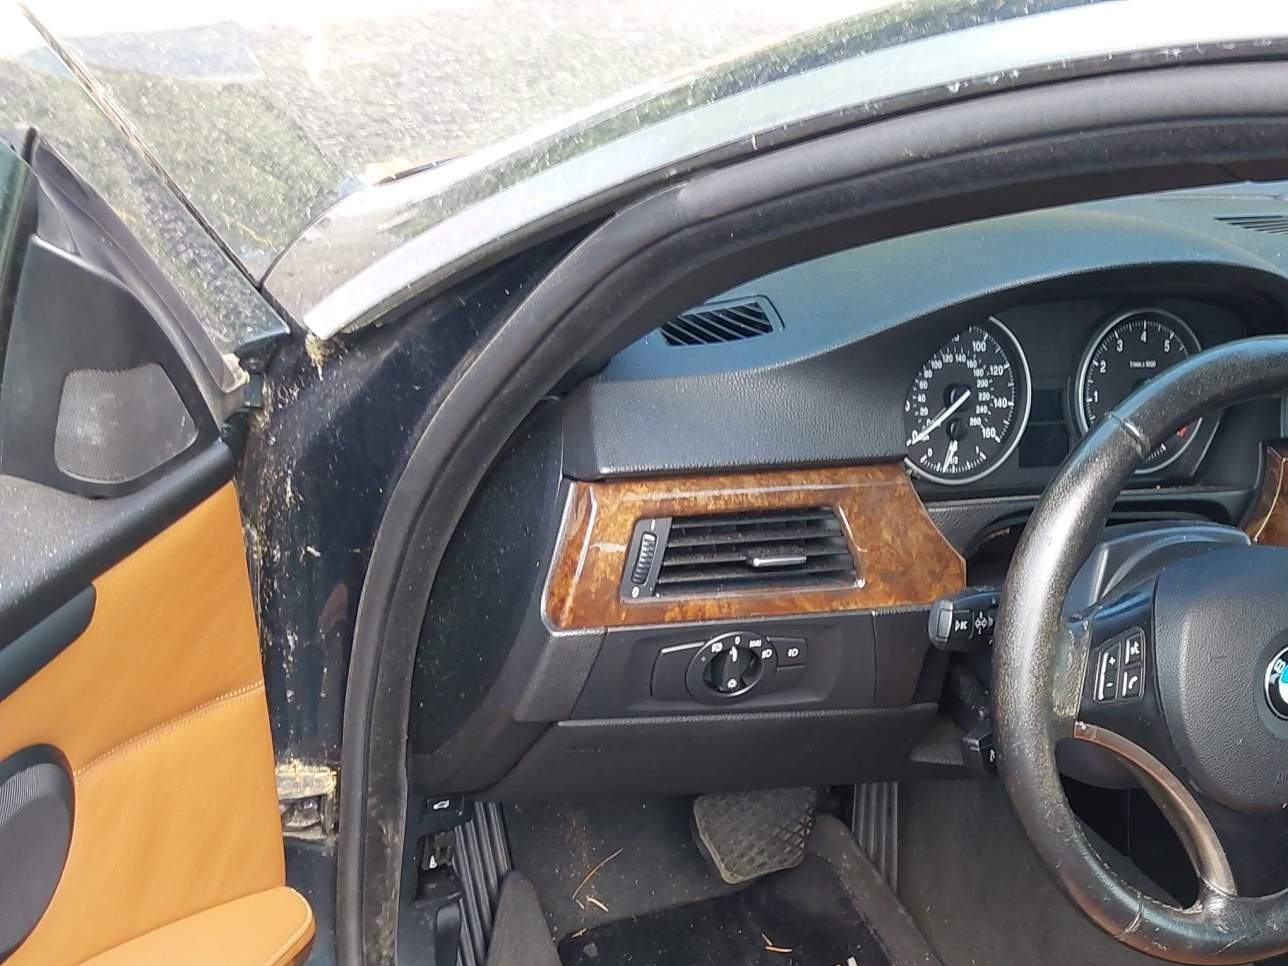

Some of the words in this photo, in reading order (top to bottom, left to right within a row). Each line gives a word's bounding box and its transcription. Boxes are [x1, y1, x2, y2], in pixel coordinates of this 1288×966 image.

[1141, 331, 1146, 342] 4
[972, 340, 987, 352] 100
[1117, 340, 1123, 352] 3
[1164, 340, 1170, 352] 5
[989, 365, 1004, 376] 120
[1100, 361, 1106, 373] 2
[1094, 391, 1098, 402] 1
[993, 397, 1008, 408] 140
[920, 407, 929, 417] 20
[981, 427, 996, 439] 160
